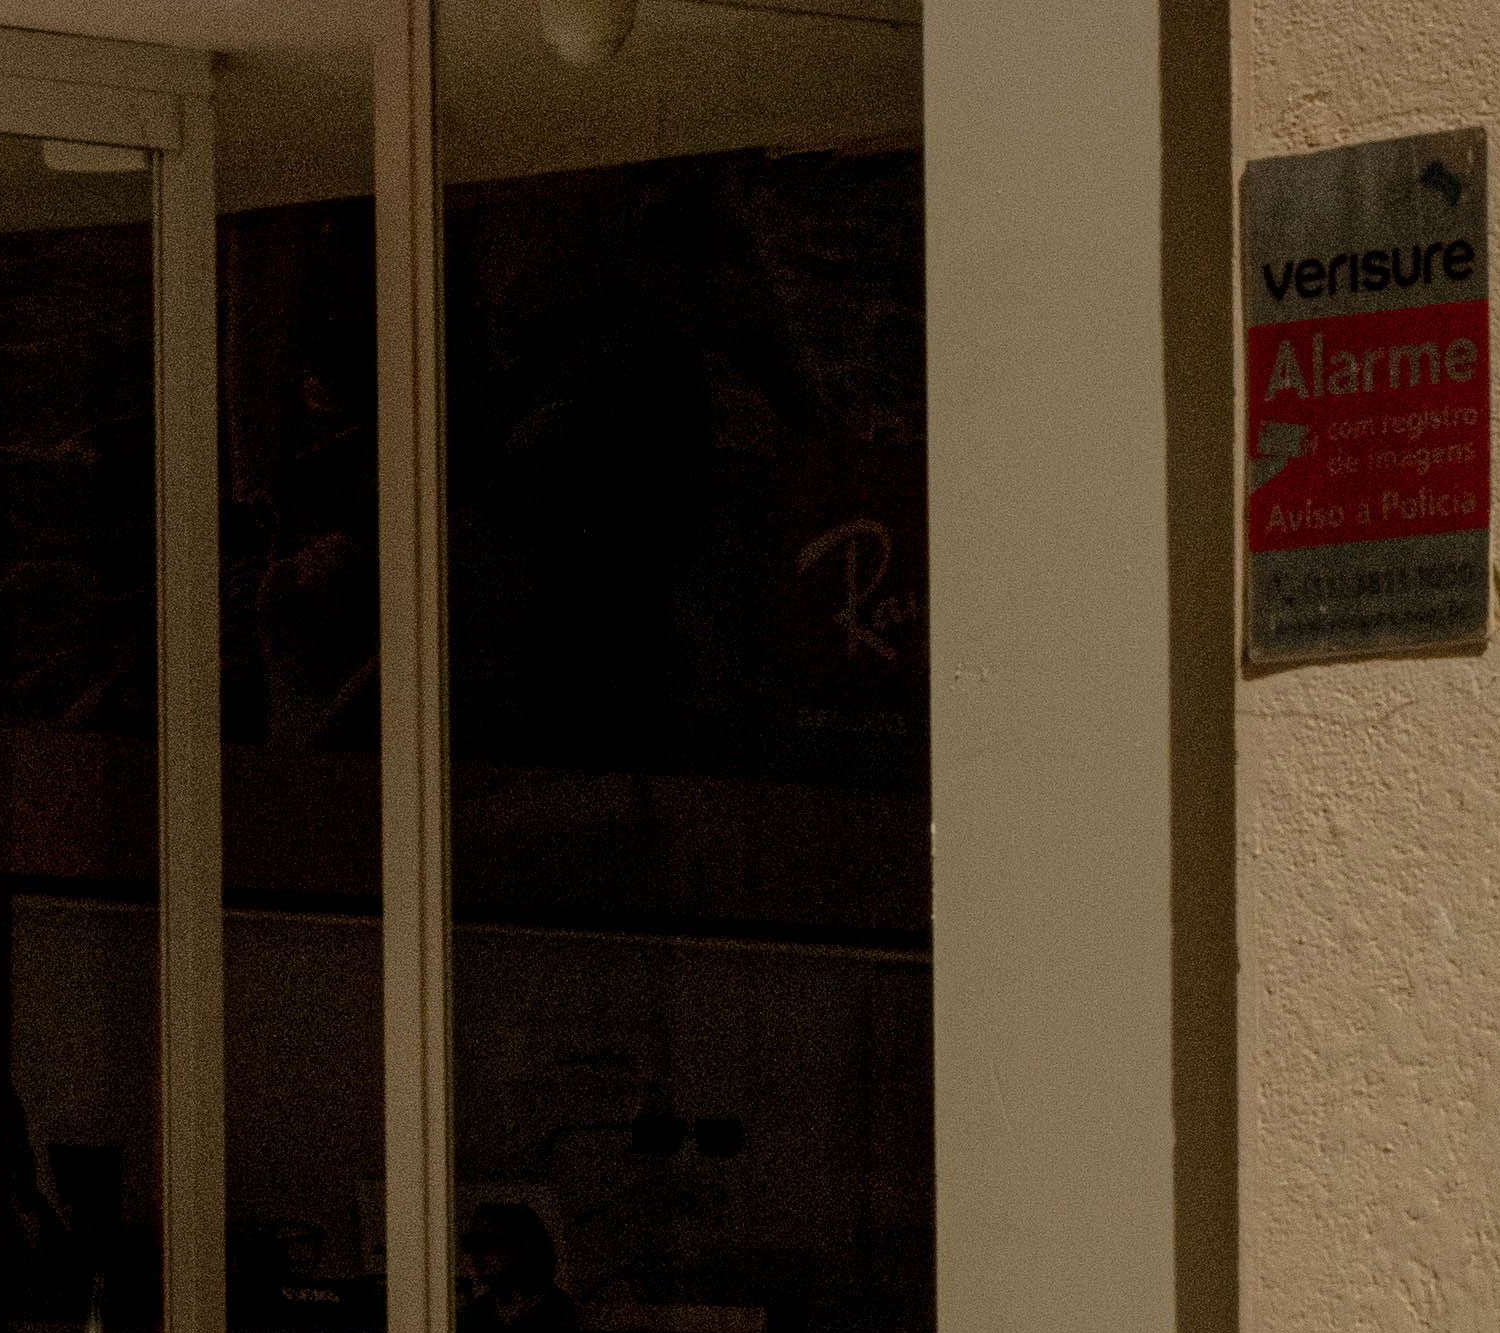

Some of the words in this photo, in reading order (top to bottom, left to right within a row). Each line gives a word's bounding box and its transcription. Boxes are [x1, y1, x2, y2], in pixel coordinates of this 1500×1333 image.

[1262, 238, 1475, 301] verisure
[1263, 332, 1479, 401] Alarme
[1264, 498, 1346, 534] Aviso
